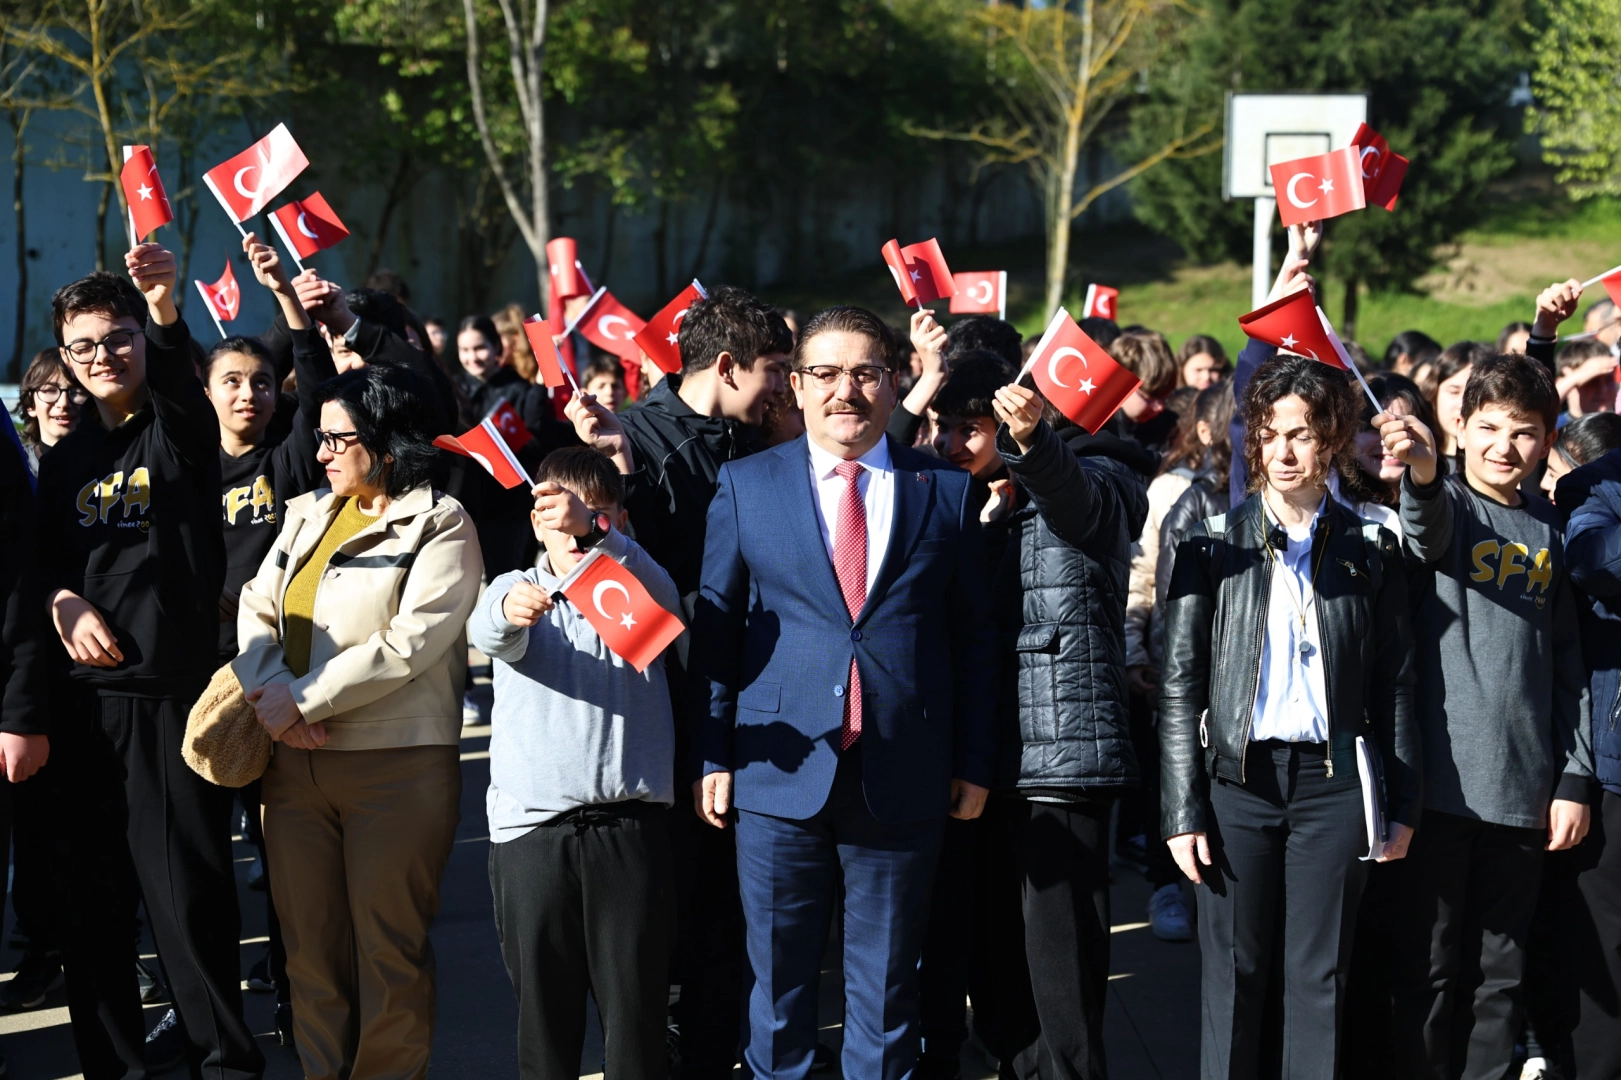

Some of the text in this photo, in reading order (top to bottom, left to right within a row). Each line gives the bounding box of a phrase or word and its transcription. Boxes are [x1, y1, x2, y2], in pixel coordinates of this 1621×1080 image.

[76, 467, 151, 527] SFA
[222, 475, 275, 526] FA
[116, 519, 136, 529] since
[1469, 539, 1552, 593] SFA
